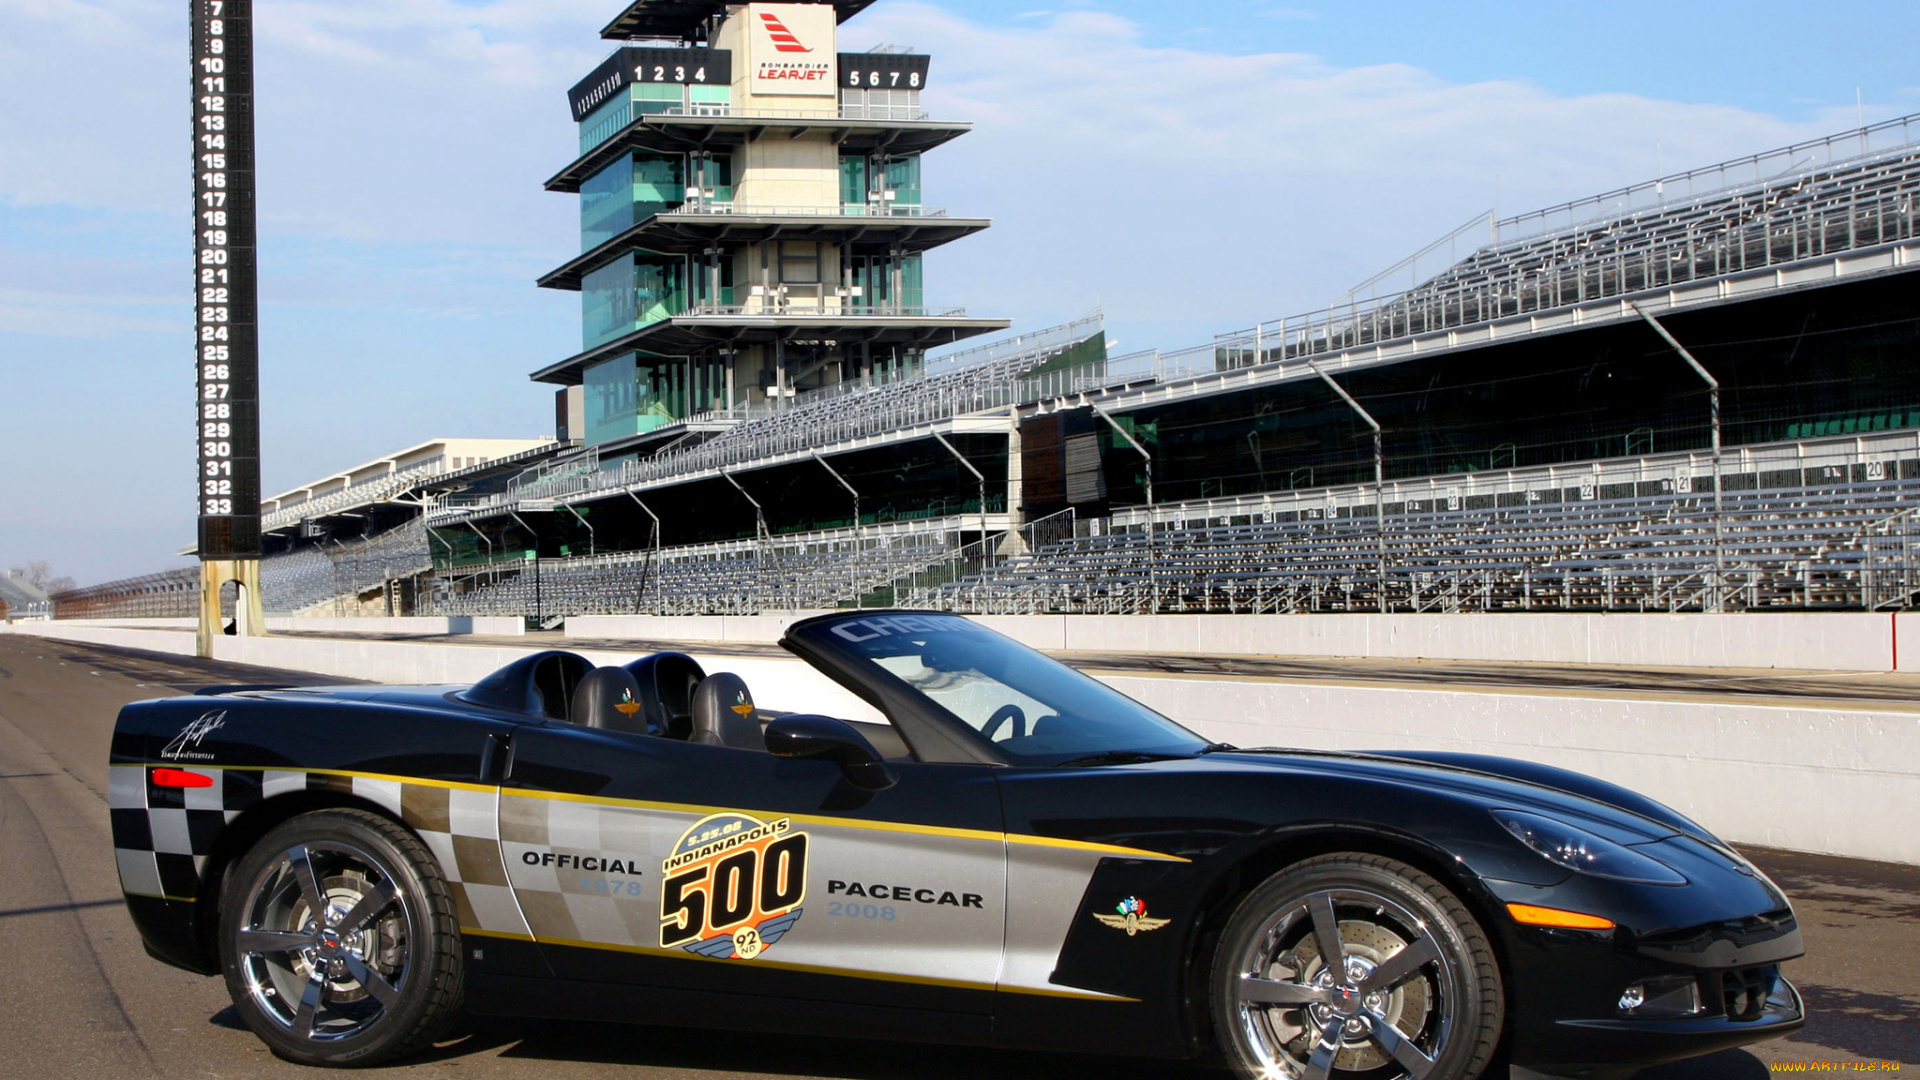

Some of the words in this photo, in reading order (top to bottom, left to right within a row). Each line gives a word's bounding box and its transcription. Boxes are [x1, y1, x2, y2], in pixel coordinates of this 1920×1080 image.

[211, 1, 222, 16] 7
[211, 19, 223, 36] 8
[211, 38, 223, 55] 9
[200, 57, 223, 74] 10
[634, 66, 642, 80] 1
[654, 66, 664, 81] 2
[674, 66, 685, 81] 3
[695, 67, 705, 82] 4
[758, 69, 828, 80] LEARJET
[849, 70, 860, 85] 5
[869, 71, 879, 86] 6
[889, 71, 899, 86] 7
[909, 72, 919, 87] 8
[202, 76, 224, 93] 11
[593, 89, 598, 103] 5
[597, 86, 603, 99] 6
[602, 82, 606, 96] 7
[201, 95, 224, 112] 12
[201, 114, 224, 131] 13
[202, 133, 225, 150] 14
[202, 153, 225, 169] 15
[202, 172, 226, 189] 16
[202, 191, 226, 208] 17
[203, 210, 226, 227] 18
[203, 229, 226, 246] 19
[202, 248, 227, 265] 20
[202, 268, 228, 284] 21
[203, 287, 228, 303] 22
[203, 306, 228, 323] 23
[202, 325, 228, 342] 24
[204, 344, 228, 362] 25
[204, 364, 229, 381] 26
[204, 383, 229, 400] 27
[204, 403, 230, 419] 28
[204, 422, 230, 438] 29
[205, 441, 230, 458] 30
[206, 460, 231, 477] 31
[1868, 461, 1883, 477] 20
[206, 479, 231, 496] 32
[1581, 483, 1592, 497] 22
[1679, 476, 1689, 491] 21
[206, 498, 232, 515] 33
[687, 820, 743, 847] 5.25.08
[664, 820, 788, 871] INDIANAPOLIS
[522, 851, 643, 876] OFFICIAL
[578, 876, 642, 897] 1978
[661, 833, 808, 946] 500
[828, 879, 984, 910] PACECAR
[826, 901, 897, 922] 2008
[736, 930, 757, 947] 92
[740, 944, 756, 955] ND
